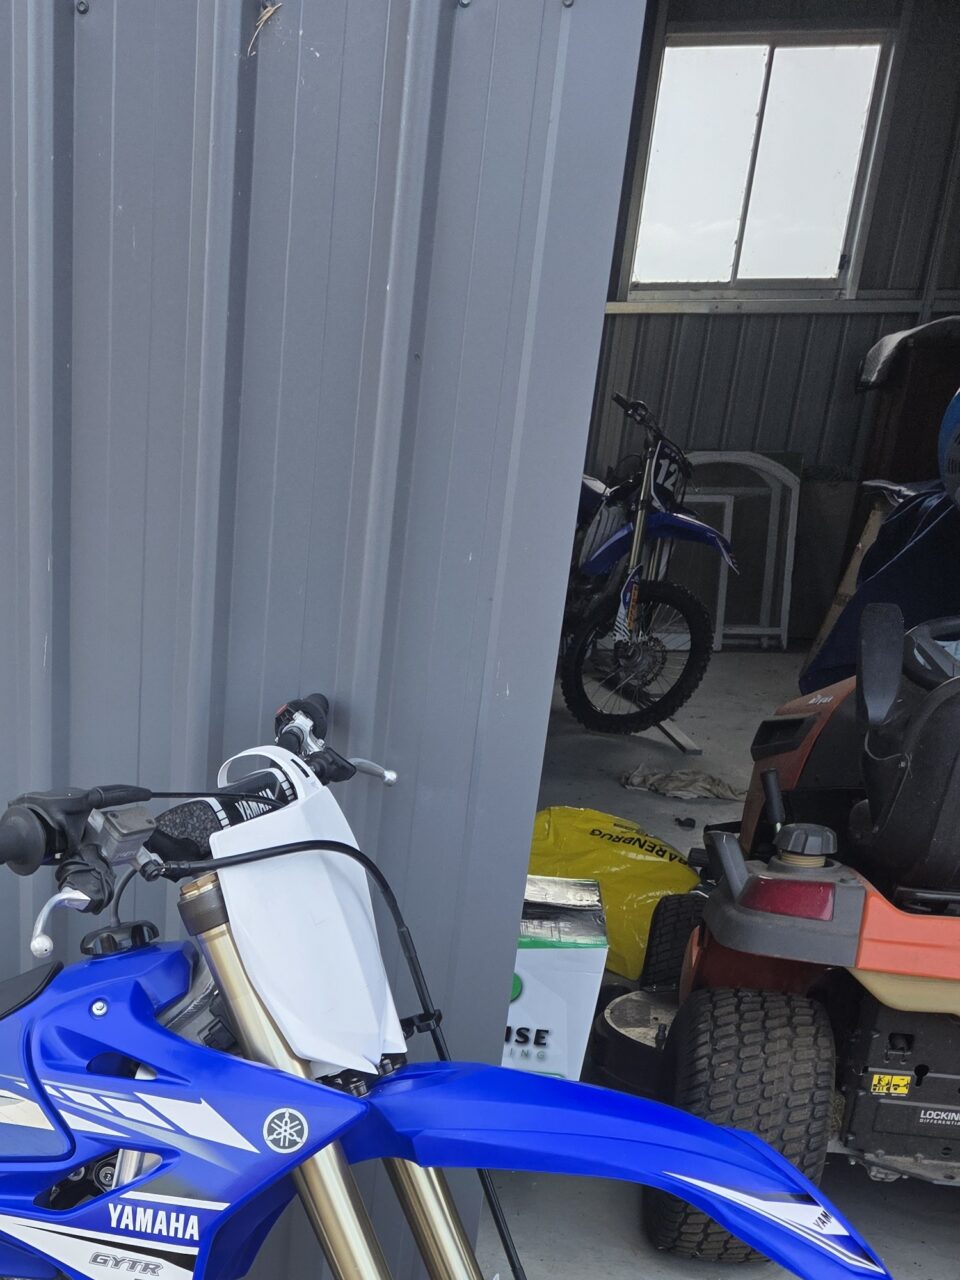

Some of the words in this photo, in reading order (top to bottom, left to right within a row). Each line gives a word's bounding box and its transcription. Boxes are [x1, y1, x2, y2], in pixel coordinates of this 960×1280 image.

[920, 1109, 960, 1121] LOCKIN
[108, 1202, 200, 1241] YAMAHA
[88, 1251, 164, 1277] GYTR
